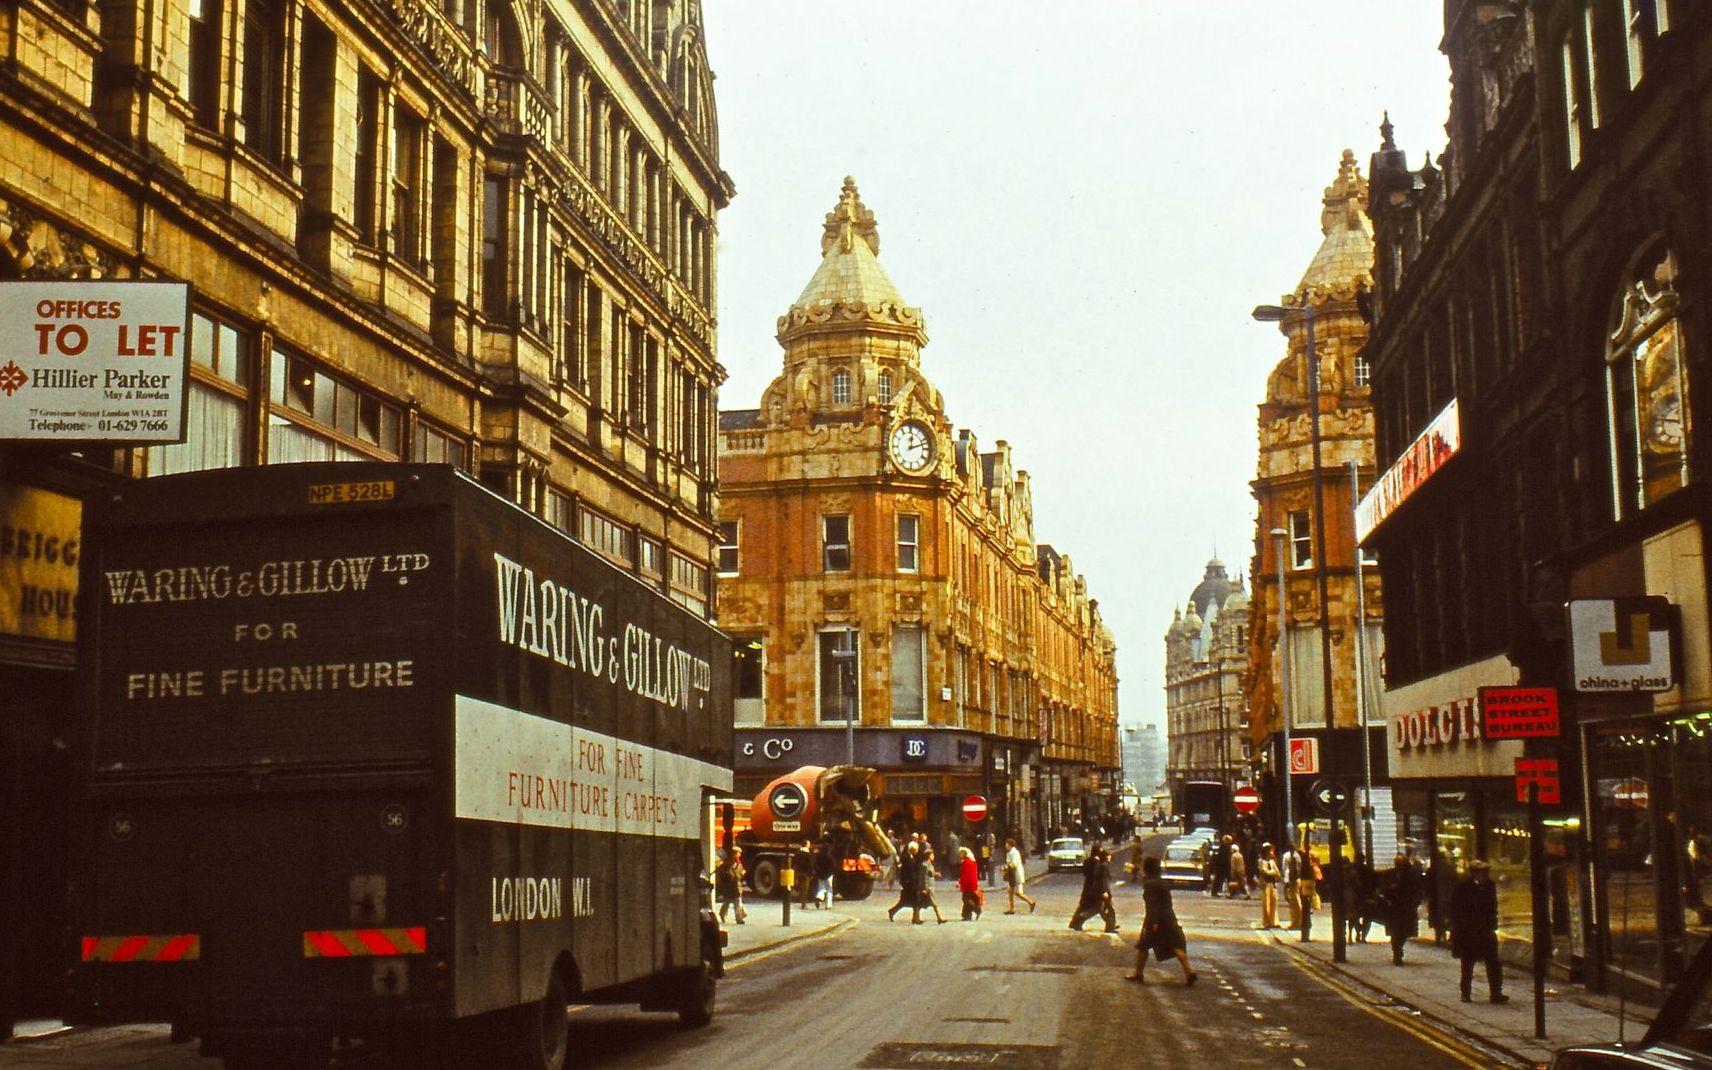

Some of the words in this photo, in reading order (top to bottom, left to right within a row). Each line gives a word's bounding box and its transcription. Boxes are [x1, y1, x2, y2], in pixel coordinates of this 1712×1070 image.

[36, 299, 121, 319] OFFICES
[34, 324, 89, 356] TO
[117, 324, 181, 357] LET
[32, 368, 98, 389] Hillier
[104, 368, 170, 389] Parker
[104, 390, 124, 401] May
[125, 390, 133, 400] &
[136, 390, 170, 400] Rowden
[102, 409, 130, 417] London
[98, 419, 138, 432] 01-629
[140, 419, 168, 432] 7666
[310, 486, 343, 502] NPE
[349, 482, 393, 500] 528L
[105, 566, 231, 604] WARING
[237, 572, 255, 597] &
[258, 557, 375, 595] GILLOW
[235, 622, 298, 642] FOR
[494, 552, 604, 677] WARING
[608, 637, 620, 685] &
[623, 623, 692, 711] GILLOW
[127, 670, 204, 699] FINE
[221, 660, 414, 695] FURNITURE
[1488, 695, 1545, 705] BROOK
[1488, 708, 1551, 719] STREET
[1489, 722, 1557, 733] BUREAU
[579, 739, 606, 775] FOR
[616, 747, 644, 782] FINE
[508, 771, 608, 818] FURNITURE
[624, 792, 677, 824] CARPETS
[387, 813, 403, 826] 56
[492, 877, 561, 922] LONDON
